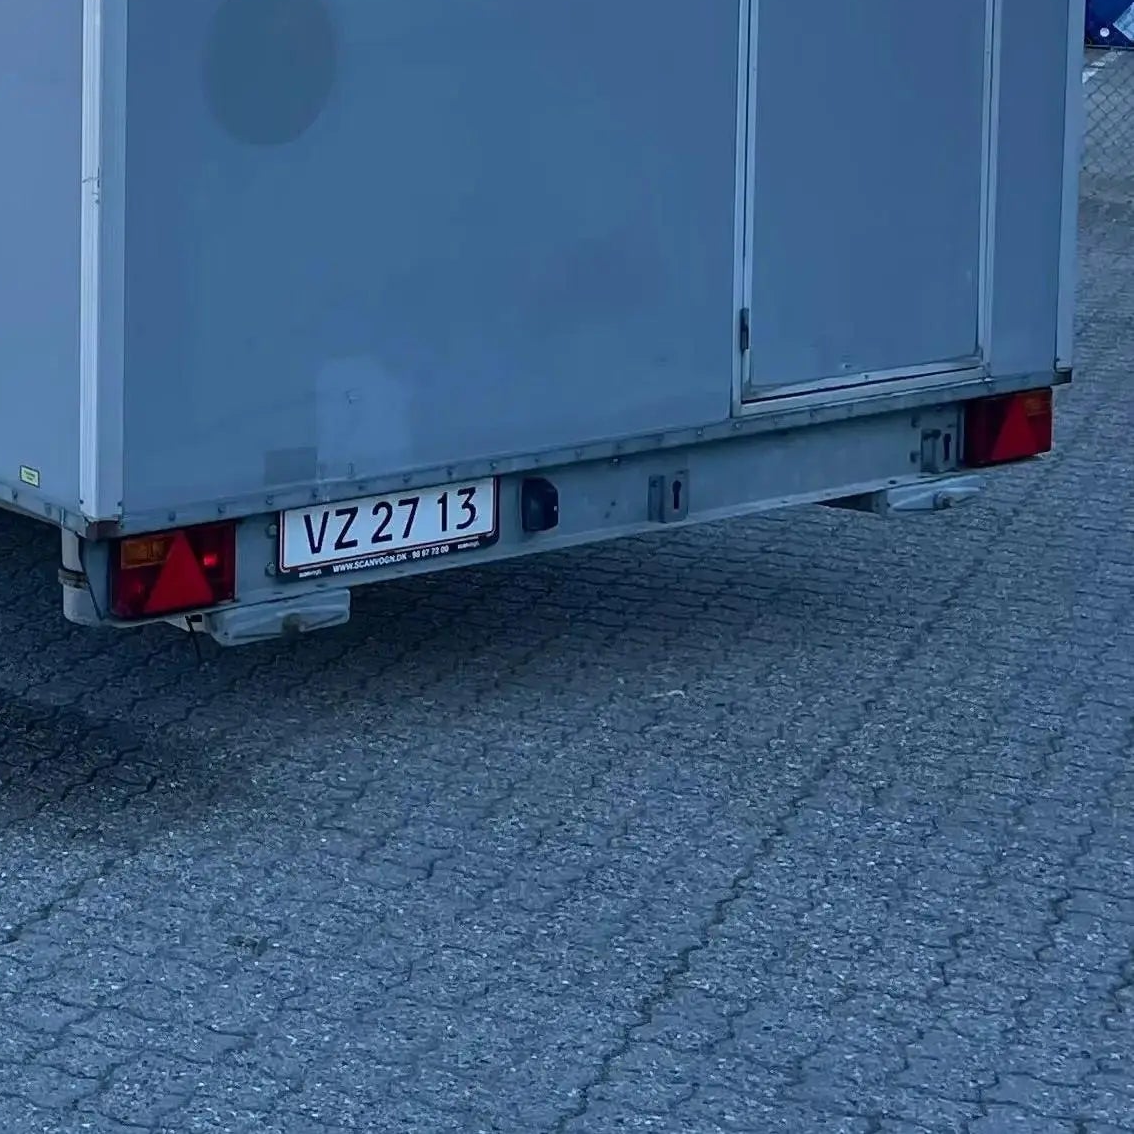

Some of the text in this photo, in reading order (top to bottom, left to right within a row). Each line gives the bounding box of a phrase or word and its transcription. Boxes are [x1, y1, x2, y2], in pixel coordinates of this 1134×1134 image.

[303, 486, 476, 555] VZ 27 13
[332, 552, 407, 573] WWW.SCANVOGN.DK
